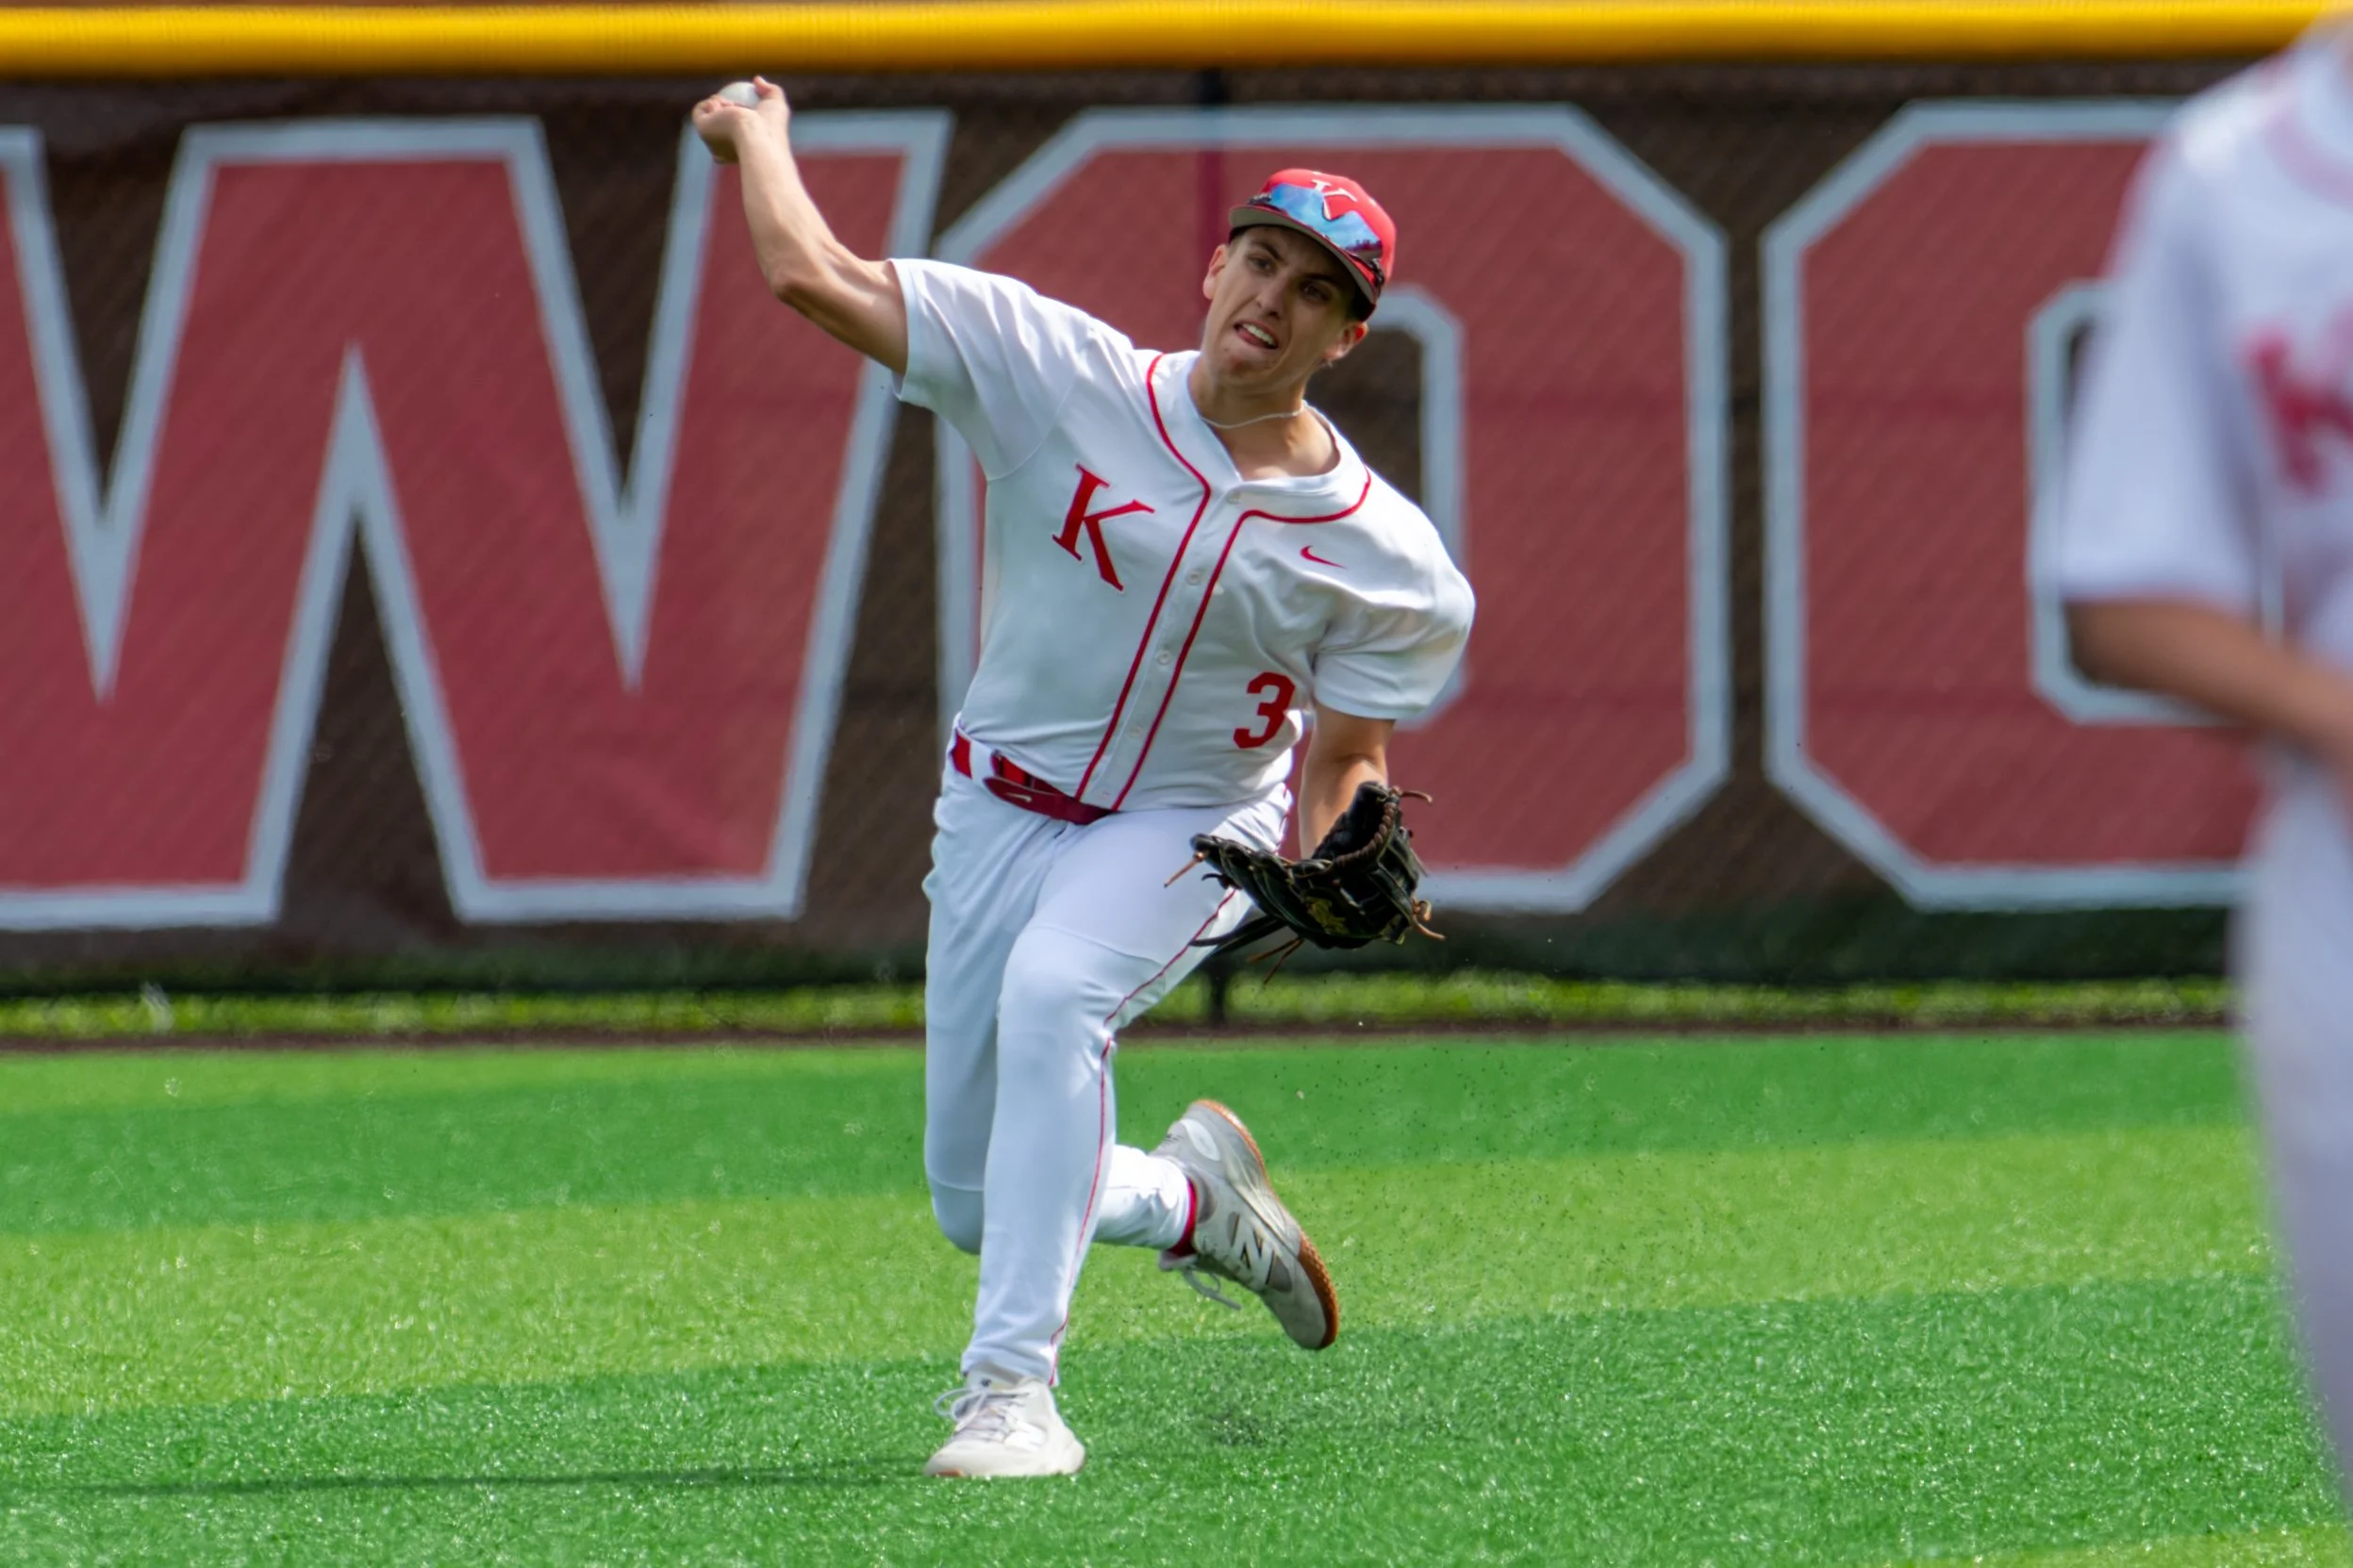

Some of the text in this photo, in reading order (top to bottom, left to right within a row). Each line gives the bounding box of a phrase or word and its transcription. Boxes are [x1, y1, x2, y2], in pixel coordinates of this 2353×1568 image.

[1311, 179, 1358, 221] K
[1052, 464, 1155, 591] K
[1233, 671, 1296, 749] 3
